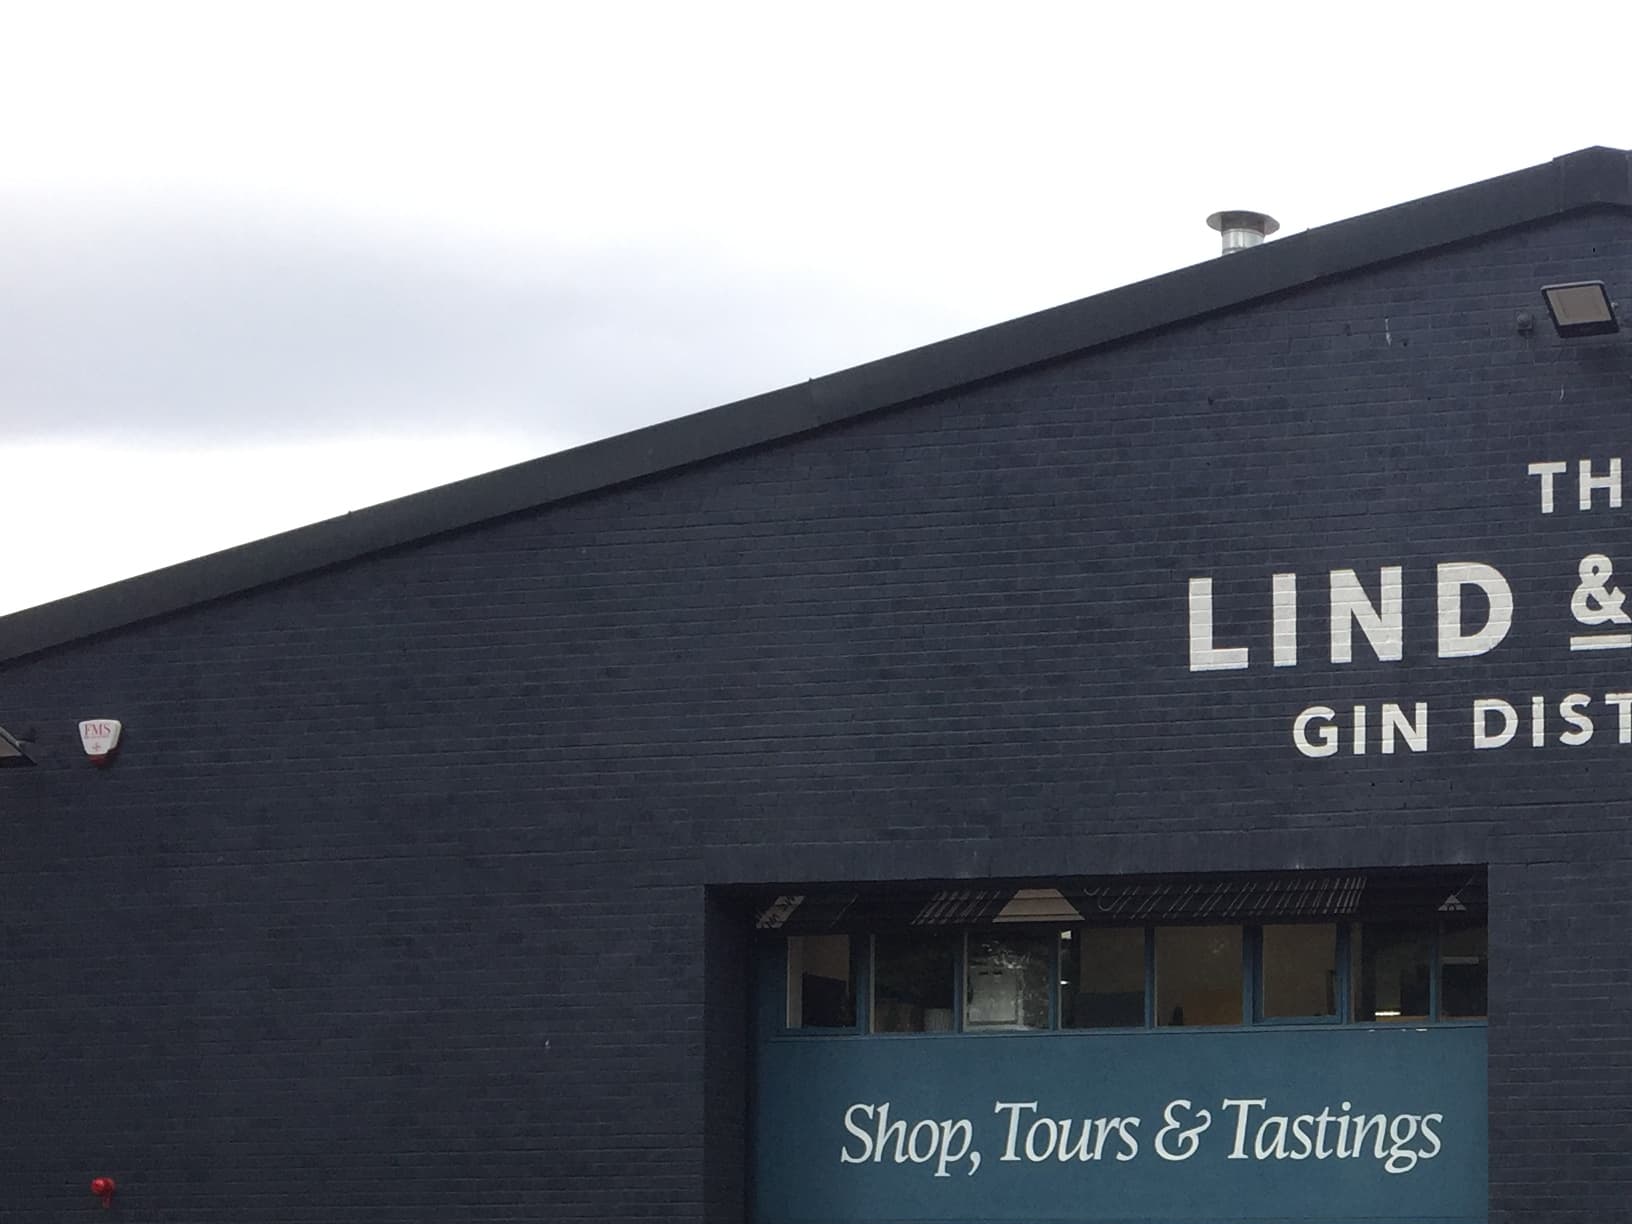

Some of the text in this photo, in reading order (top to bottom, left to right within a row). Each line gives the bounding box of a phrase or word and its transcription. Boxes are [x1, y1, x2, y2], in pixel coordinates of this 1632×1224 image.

[1189, 560, 1515, 673] LIND
[1292, 701, 1429, 759] GIN
[840, 1097, 1444, 1177] Shop, Tours & Tastings
